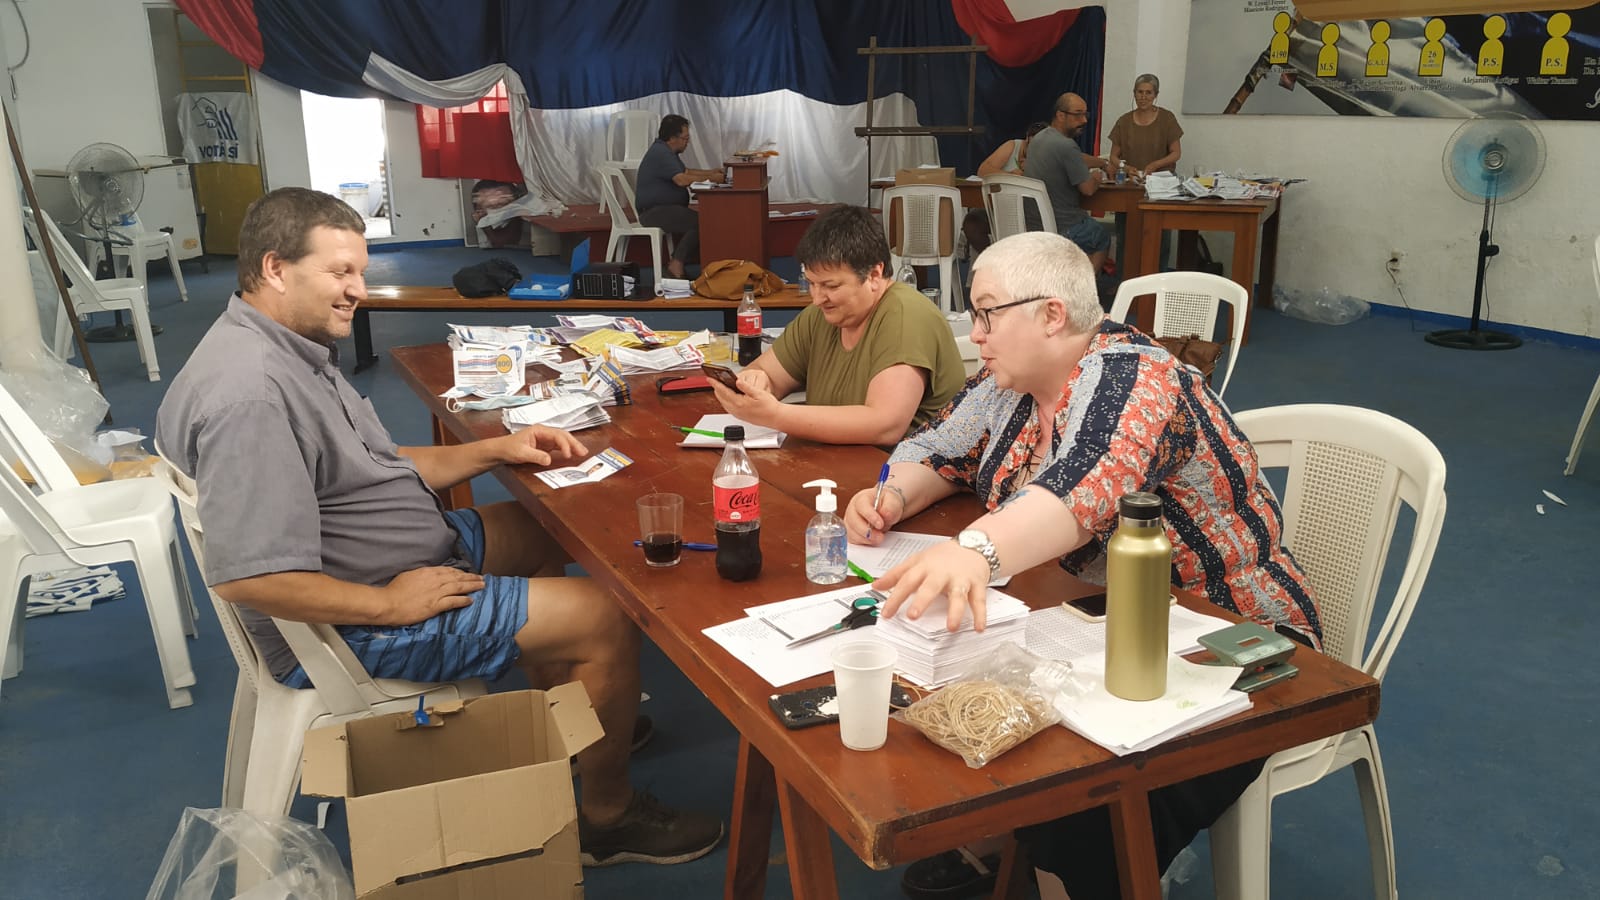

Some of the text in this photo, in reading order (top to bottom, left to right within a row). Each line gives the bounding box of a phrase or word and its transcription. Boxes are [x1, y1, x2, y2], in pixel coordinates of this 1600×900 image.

[1319, 62, 1336, 71] M.S.
[1483, 57, 1499, 67] P.S.
[1545, 57, 1563, 67] P.S.
